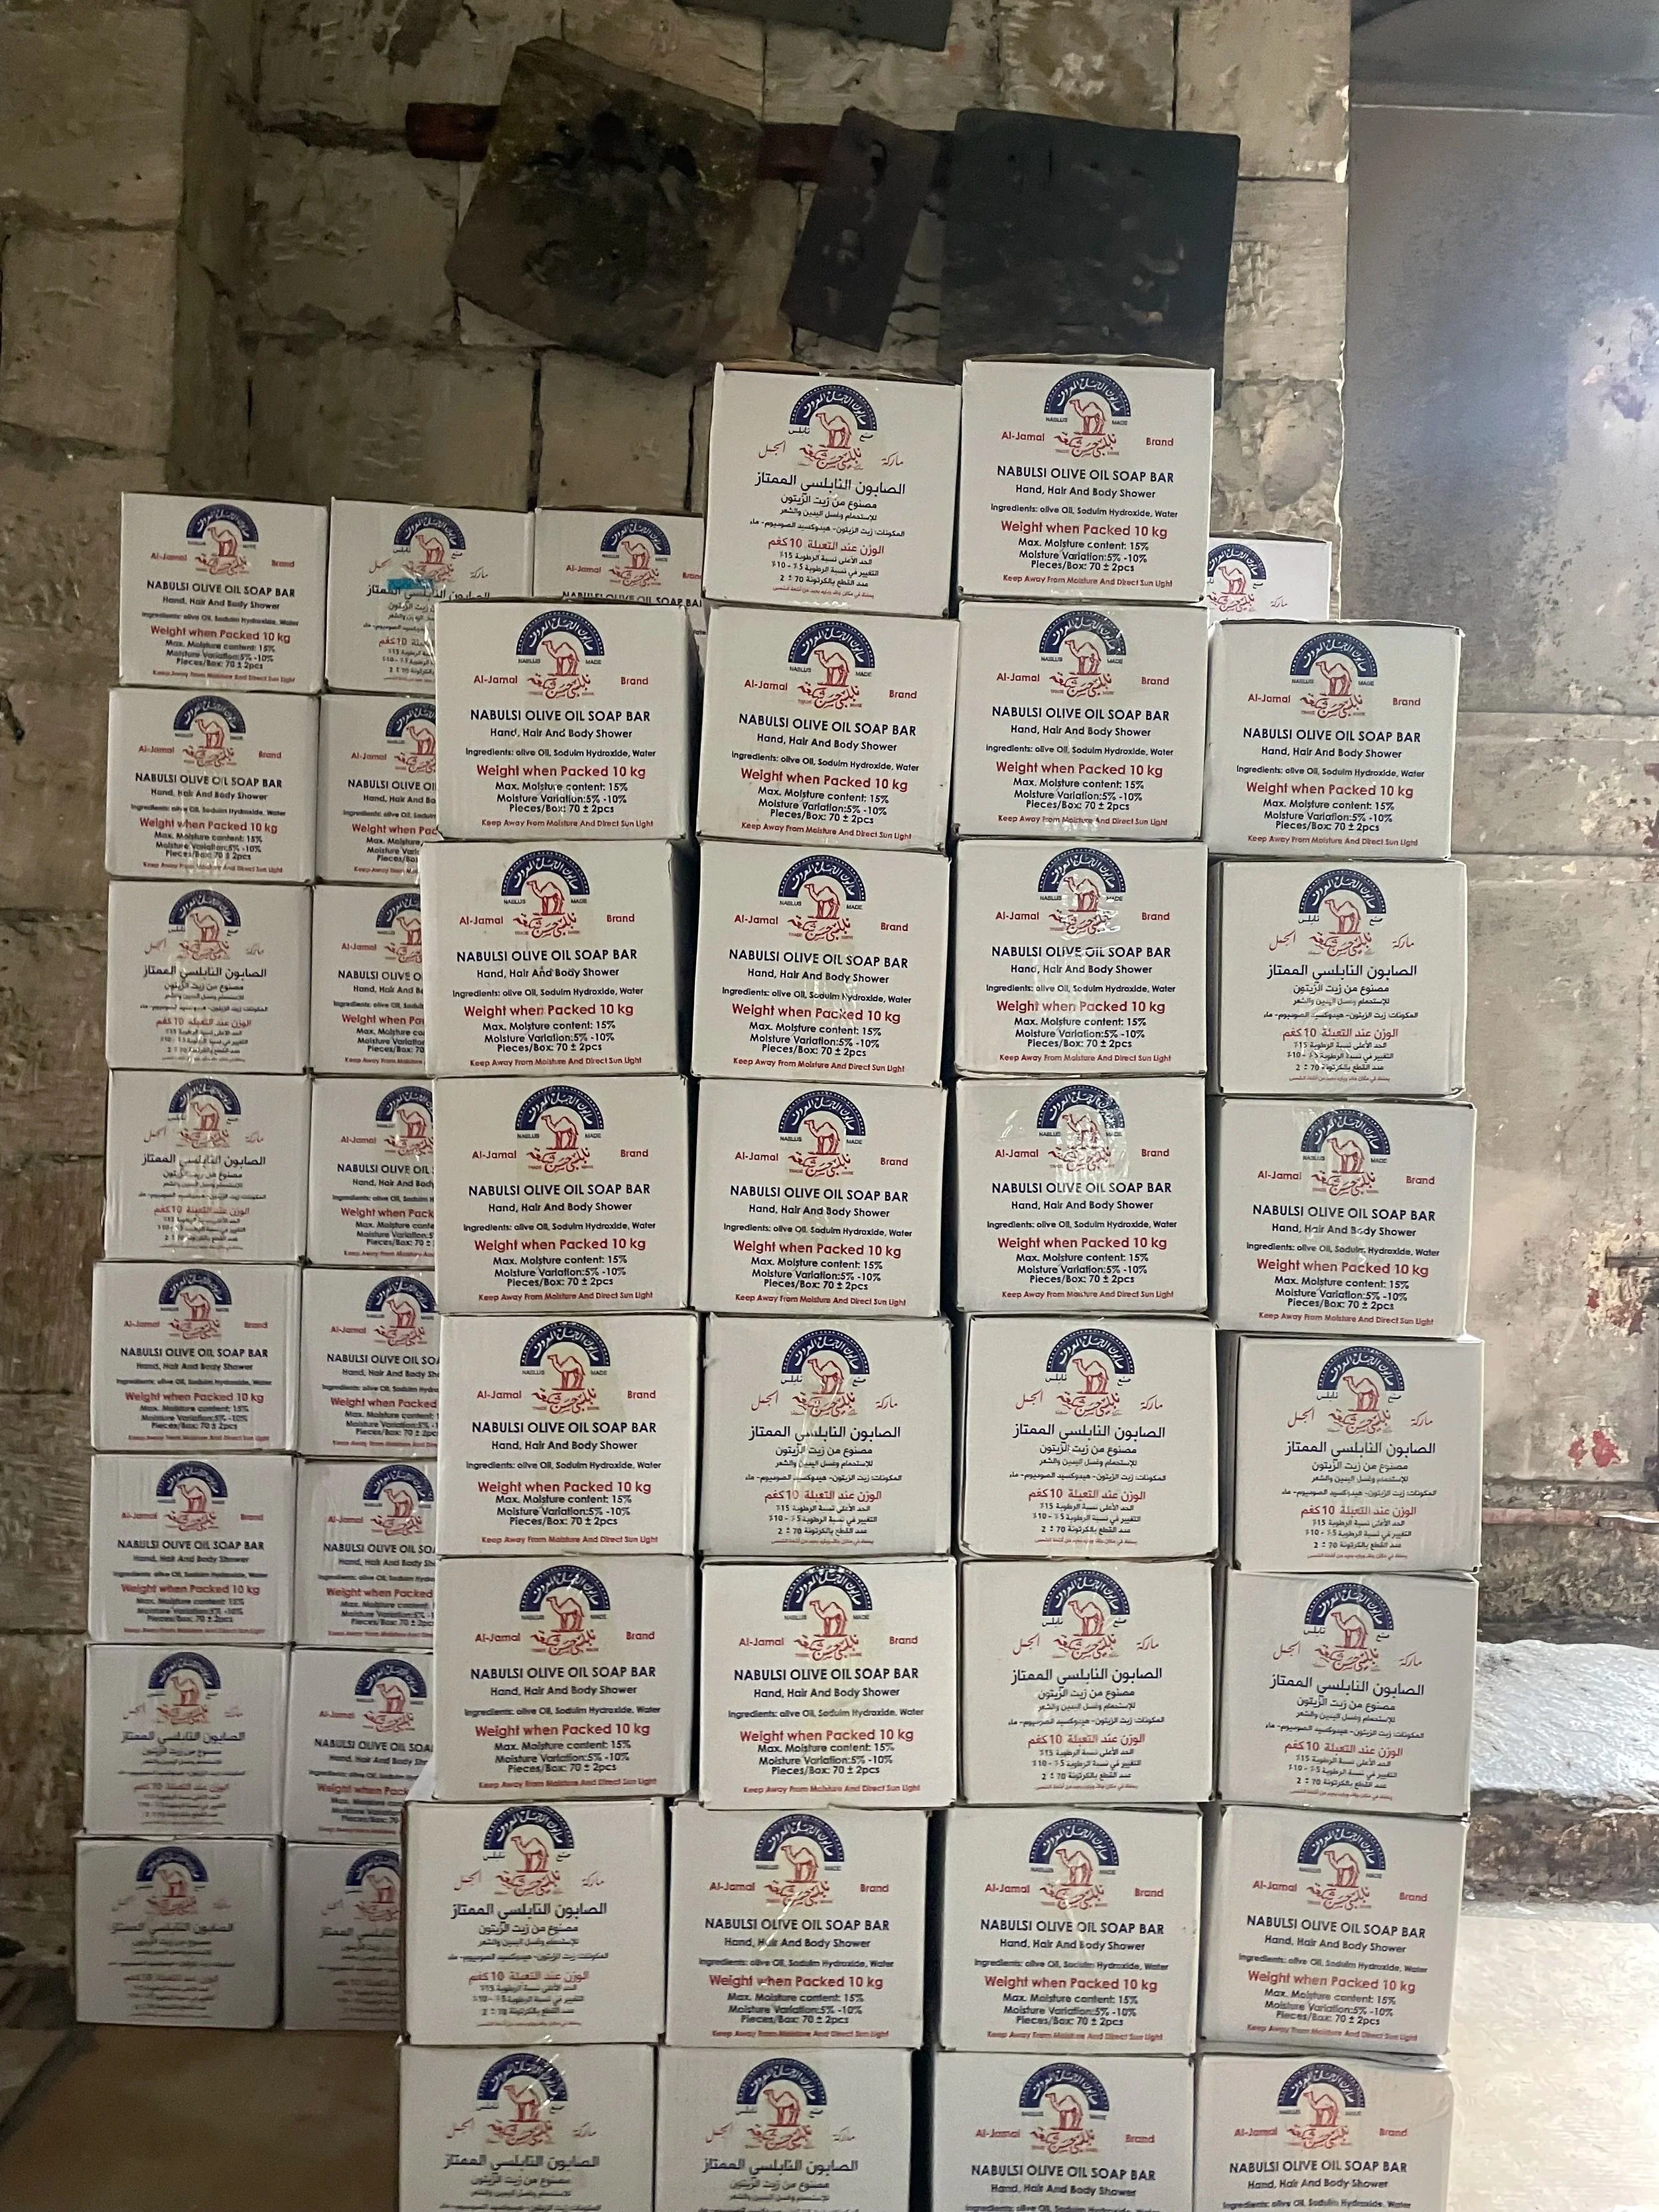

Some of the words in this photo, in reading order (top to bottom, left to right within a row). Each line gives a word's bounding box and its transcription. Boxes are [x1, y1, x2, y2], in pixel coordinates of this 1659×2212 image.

[1001, 431, 1045, 441] Al-Jamal
[1146, 437, 1173, 446] Brand
[755, 472, 796, 486] الممتاز
[997, 466, 1046, 477] NABULSI
[1051, 468, 1086, 479] OLIVE
[1089, 470, 1110, 480] OIL
[1113, 471, 1146, 481] SOAP
[1151, 472, 1173, 482] BAR
[800, 478, 851, 495] النابلسي
[855, 482, 905, 497] الصابون
[1262, 747, 1289, 756] Hand,
[1315, 748, 1335, 757] And
[1338, 749, 1363, 759] Body
[1365, 749, 1402, 758] Shower
[477, 765, 519, 778] Weight
[523, 765, 557, 776] when
[561, 766, 608, 776] Packed
[613, 767, 626, 776] 10
[630, 766, 645, 779] kg
[850, 761, 893, 771] Hydroxide,
[457, 951, 507, 962] NABULSI
[512, 950, 547, 961] OLIVE
[551, 950, 571, 960] OIL
[575, 950, 609, 960] SOAP
[613, 949, 636, 960] BAR
[1267, 964, 1307, 979] الممتاز
[1313, 964, 1362, 984] النابلسي
[1367, 965, 1416, 980] الصابون
[776, 1023, 816, 1035] Moisture
[863, 1027, 881, 1036] 15%
[731, 1185, 780, 1197] NABULSI
[784, 1187, 820, 1199] OLIVE
[824, 1189, 843, 1199] OIL
[847, 1190, 880, 1201] SOAP
[885, 1191, 908, 1202] BAR
[1258, 1258, 1301, 1272] Weight
[1303, 1260, 1337, 1272] when
[1342, 1262, 1390, 1274] Packed
[1395, 1264, 1409, 1274] 10
[1412, 1264, 1428, 1278] kg
[1112, 1275, 1134, 1284] 2pcs
[472, 1422, 524, 1433] NABULSI
[528, 1422, 565, 1433] OLIVE
[568, 1422, 589, 1433] OIL
[592, 1422, 627, 1433] SOAP
[632, 1422, 656, 1432] BAR
[1285, 1441, 1327, 1455] الممتاز
[1331, 1441, 1382, 1461] النابلسي
[1386, 1443, 1435, 1458] الصابون
[475, 1633, 520, 1642] Al-Jamal
[626, 1631, 654, 1640] Brand
[740, 1728, 784, 1743] Weight
[787, 1730, 822, 1741] when
[826, 1727, 875, 1740] Packed
[880, 1728, 893, 1739] 10
[898, 1728, 913, 1741] kg
[1028, 1735, 1048, 1748] كغم
[1049, 1733, 1062, 1744] 10
[1067, 1734, 1098, 1743] التعبئة
[1101, 1733, 1118, 1743] عند
[1120, 1733, 1145, 1745] الوزن
[705, 1918, 757, 1930] NABULSI
[761, 1919, 798, 1930] OLIVE
[802, 1919, 822, 1930] OIL
[826, 1920, 861, 1930] SOAP
[865, 1920, 889, 1930] BAR
[1000, 1939, 1030, 1948] Hand,
[1056, 1940, 1076, 1949] And
[1079, 1941, 1106, 1951] Body
[1108, 1941, 1145, 1951] Shower
[1335, 2014, 1346, 2023] 70
[1357, 2016, 1380, 2026] 2pcs
[1234, 2127, 1277, 2136] Al-Jamal
[972, 2165, 1023, 2176] NABULSI
[1027, 2165, 1063, 2177] OLIVE
[1067, 2166, 1087, 2177] OIL
[1091, 2168, 1127, 2179] SOAP
[1131, 2170, 1155, 2180] BAR
